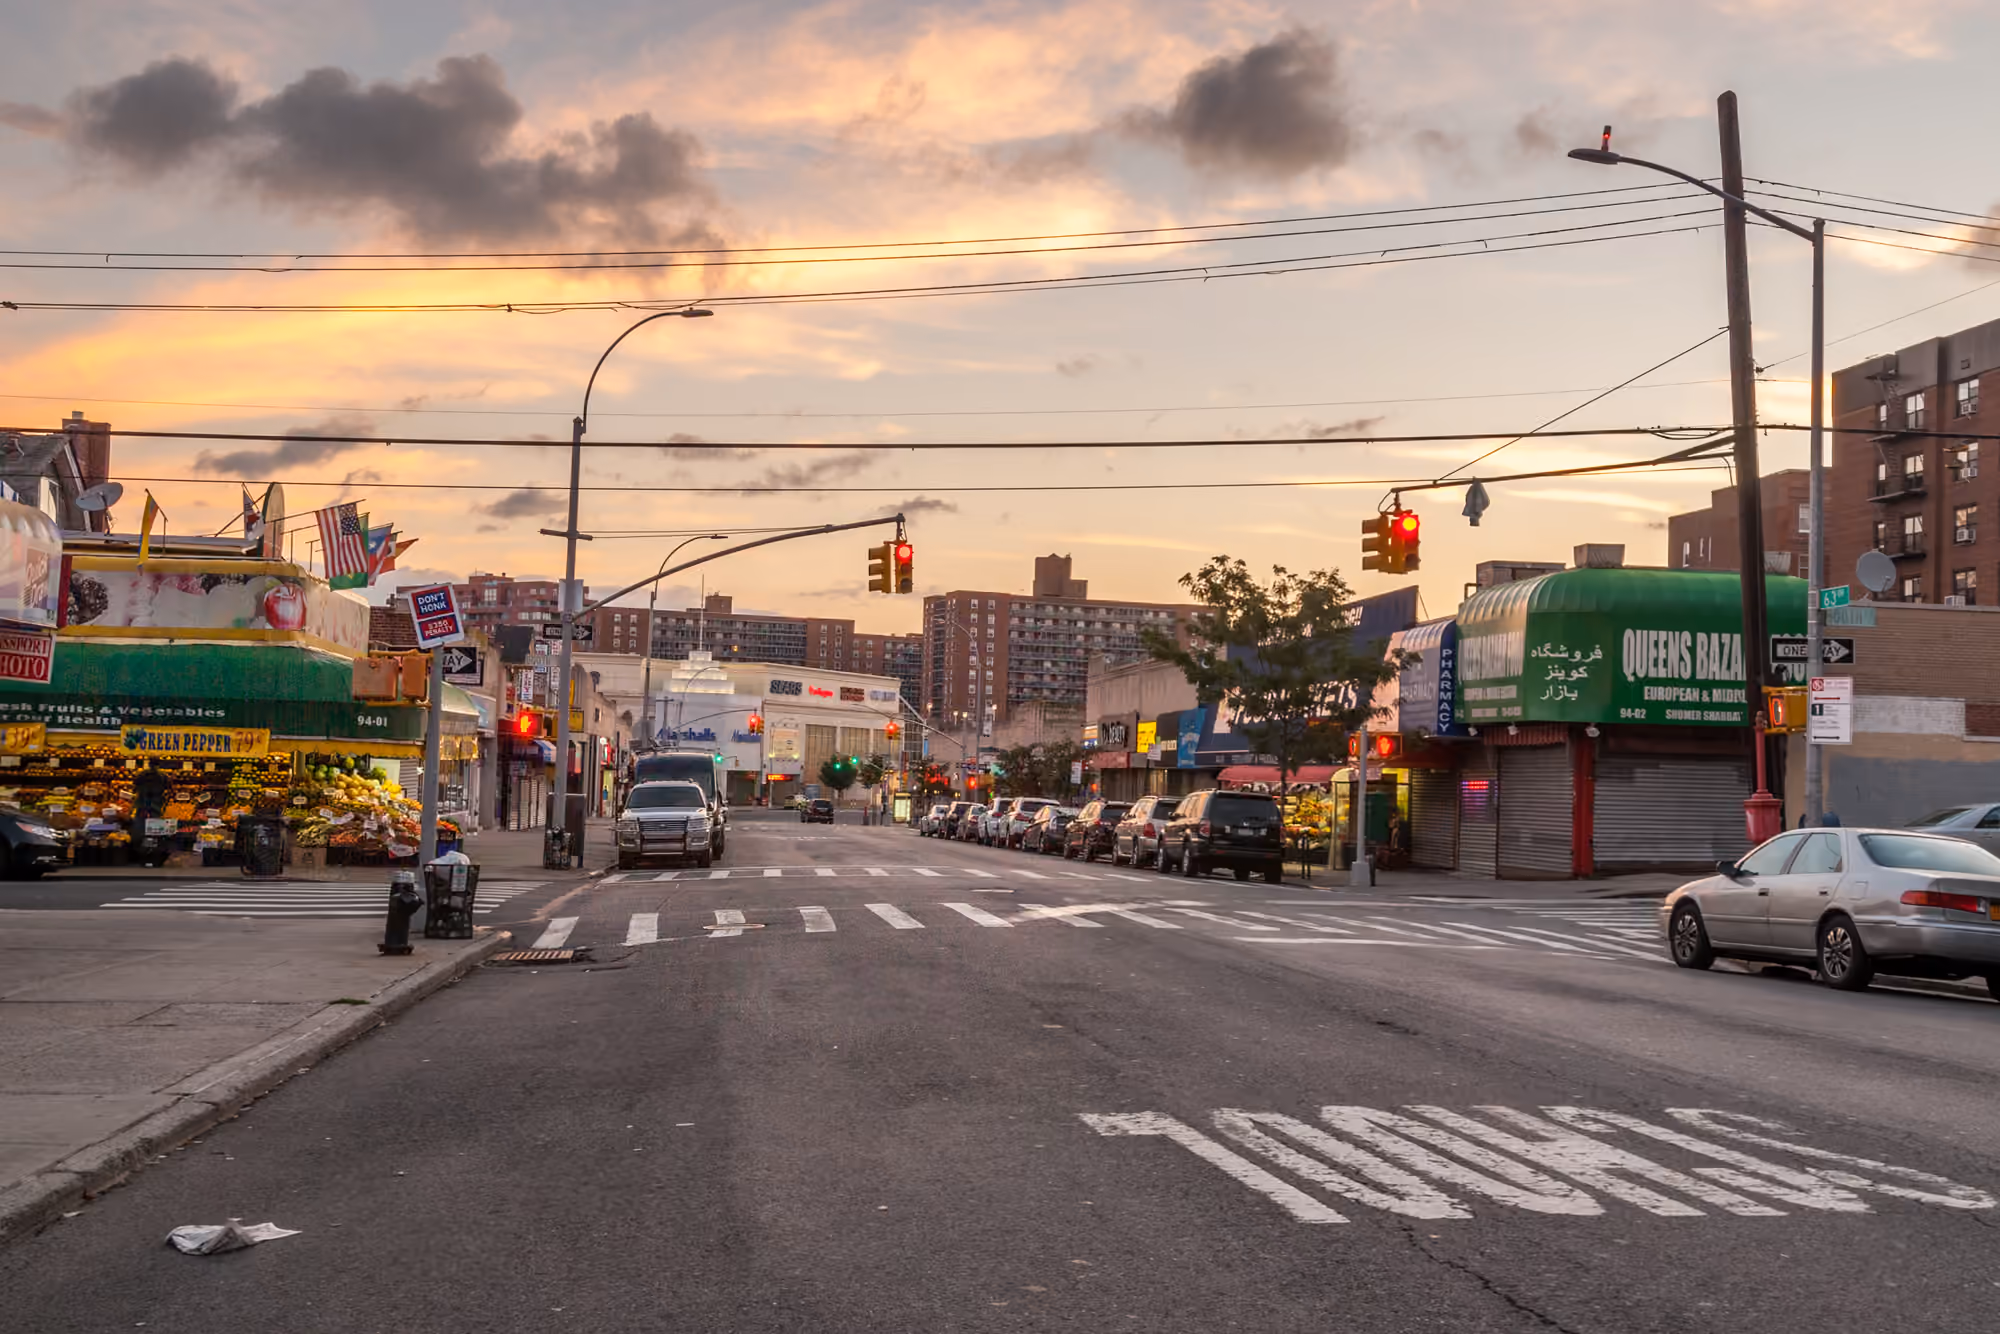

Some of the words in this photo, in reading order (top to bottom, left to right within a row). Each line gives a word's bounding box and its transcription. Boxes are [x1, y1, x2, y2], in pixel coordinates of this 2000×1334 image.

[417, 592, 445, 605] DON'T
[1824, 590, 1836, 606] 63
[420, 601, 447, 613] HONK
[424, 626, 453, 637] PENALTY
[1622, 628, 1692, 682] QUEENS
[1695, 632, 1747, 682] BAZA
[1783, 645, 1808, 656] ONE
[1823, 645, 1841, 657] AY
[1438, 649, 1453, 732] PHARMACY
[1644, 686, 1700, 702] EUROPEAN
[1702, 690, 1711, 702] &
[1712, 688, 1748, 704] MIDDL
[38, 704, 93, 713] Fruits
[99, 706, 112, 714] &
[118, 706, 226, 718] Vegetables
[1620, 708, 1647, 719] 94-02
[57, 715, 122, 725] Health
[357, 715, 388, 727] 94-01
[140, 731, 180, 751] GREEN
[183, 733, 232, 753] PEPPER
